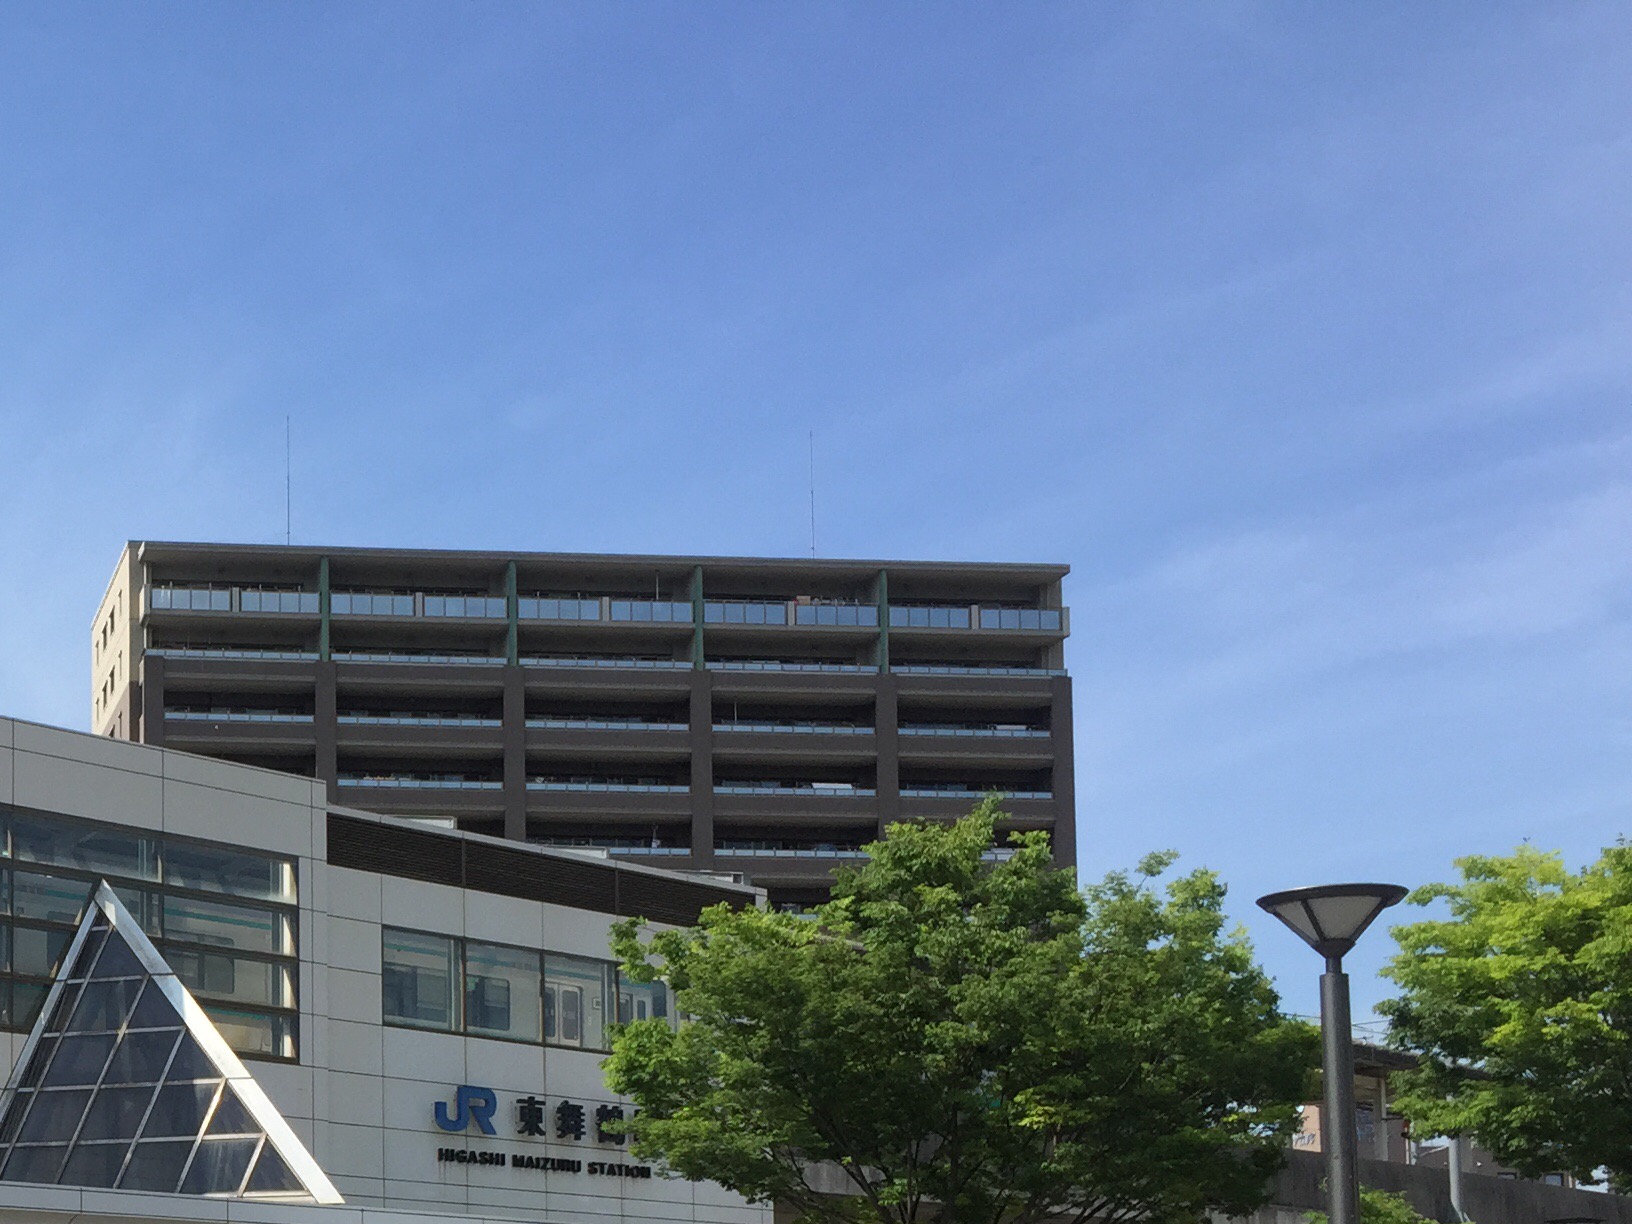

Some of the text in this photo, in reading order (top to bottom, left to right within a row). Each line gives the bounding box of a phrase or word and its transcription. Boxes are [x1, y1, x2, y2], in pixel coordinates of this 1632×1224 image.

[434, 1085, 498, 1135] JR
[437, 1147, 651, 1179] HIGASHI MAIZURU STATION
